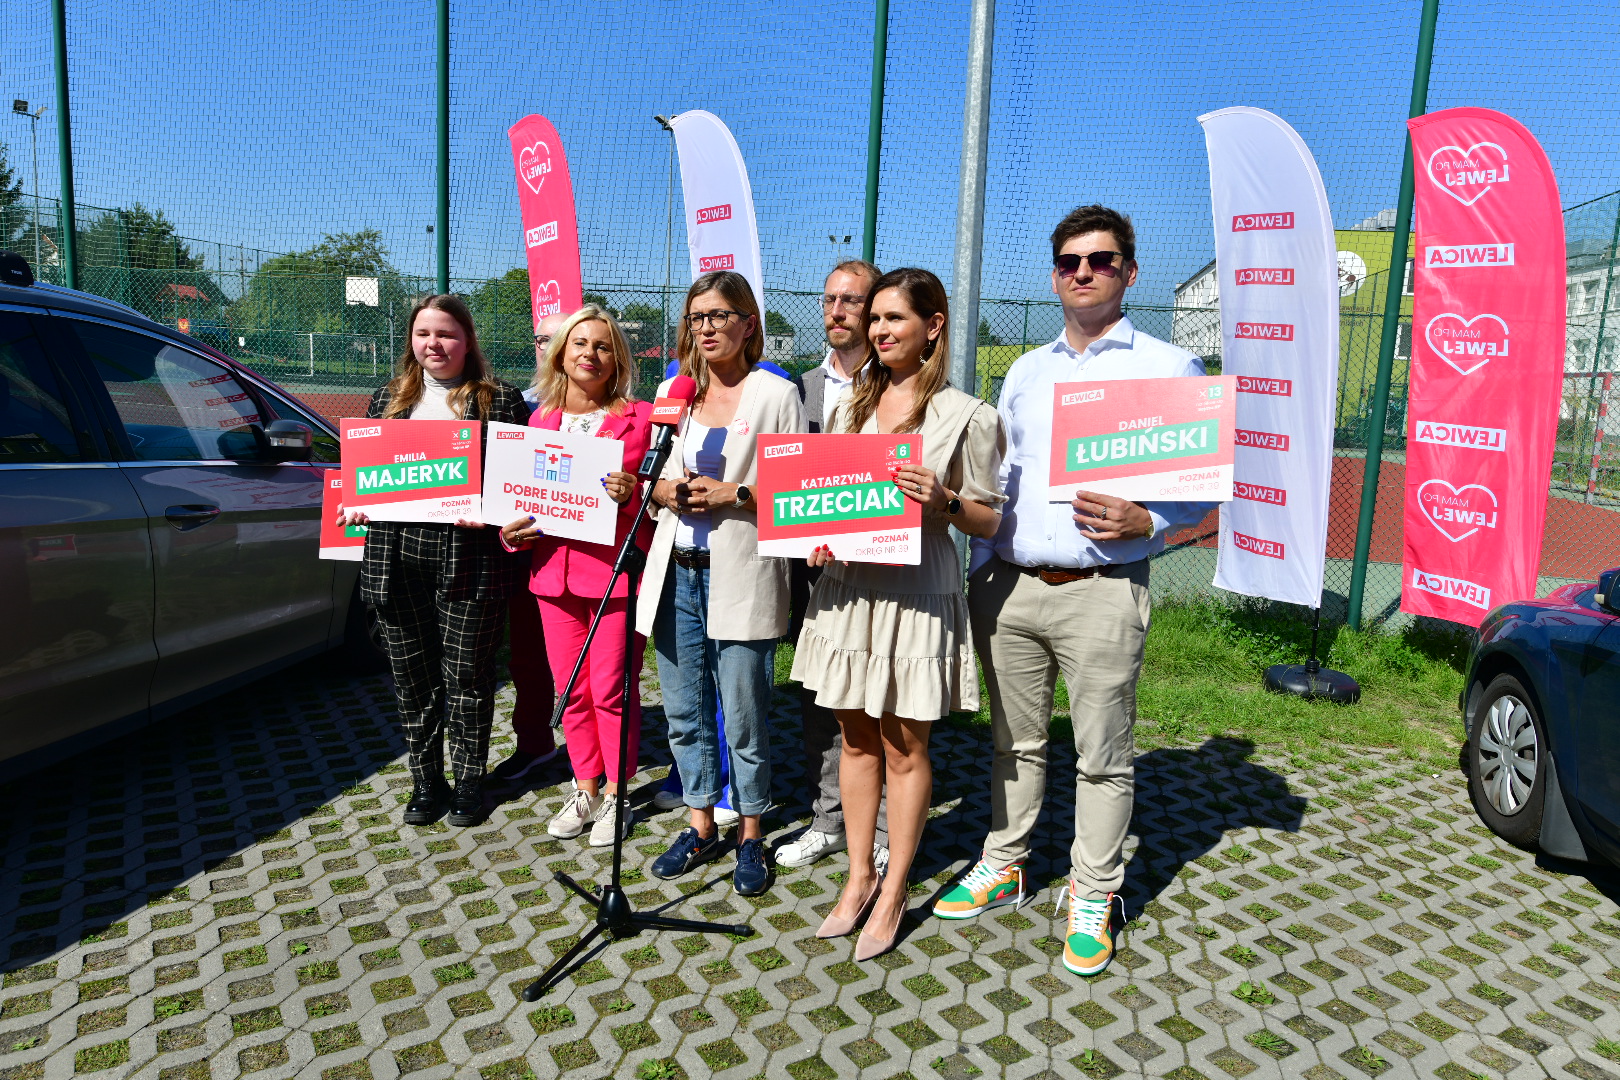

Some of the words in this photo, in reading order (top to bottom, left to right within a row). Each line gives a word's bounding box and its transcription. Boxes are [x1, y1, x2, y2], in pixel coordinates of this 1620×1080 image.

[1064, 391, 1102, 404] LEWICA
[1208, 386, 1222, 398] 13
[1119, 415, 1164, 431] DANIEL
[349, 427, 380, 438] LEWICA
[462, 429, 468, 439] 8
[766, 444, 801, 456] LEWICA
[899, 445, 907, 457] 6
[1076, 427, 1208, 464] ŁUBIŃSKI
[394, 452, 427, 463] EMILIA
[358, 461, 464, 489] MAJERYK
[801, 472, 872, 489] KATARZYNA
[1178, 469, 1220, 483] POZNAŃ
[1192, 483, 1204, 492] NR
[503, 482, 548, 500] DOBRE
[551, 490, 599, 508] USŁUGI
[441, 497, 472, 508] POZNAŃ
[774, 486, 902, 519] TRZECIAK
[514, 500, 585, 522] PUBLICZNE
[872, 532, 909, 544] POZNAŃ
[884, 546, 896, 555] NR
